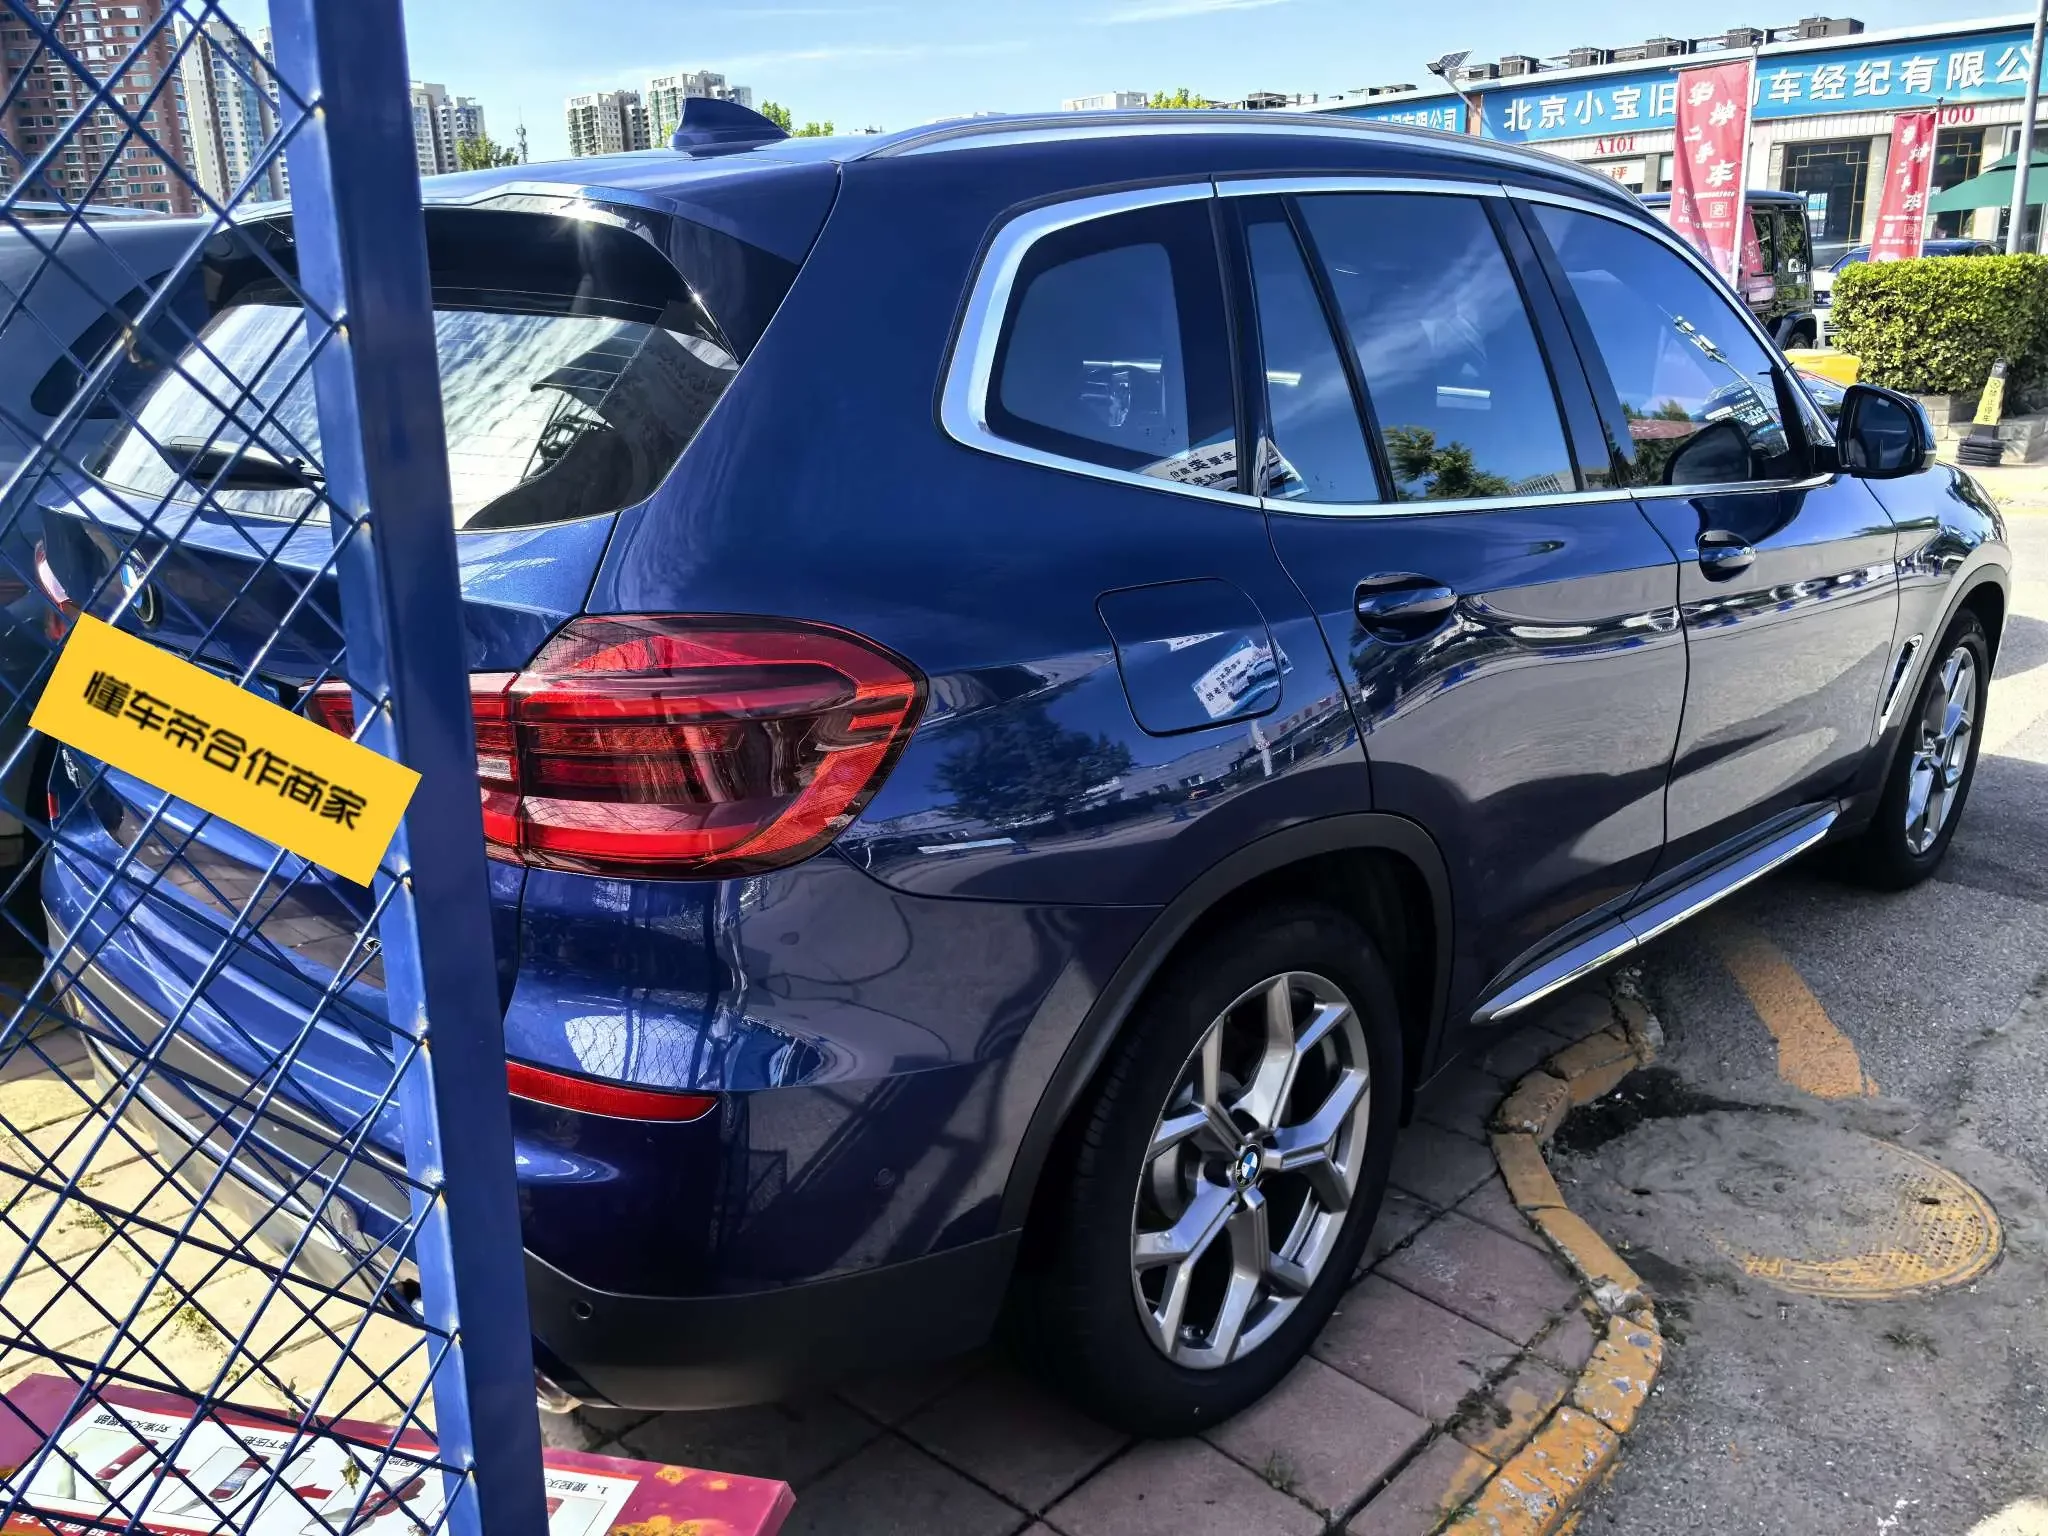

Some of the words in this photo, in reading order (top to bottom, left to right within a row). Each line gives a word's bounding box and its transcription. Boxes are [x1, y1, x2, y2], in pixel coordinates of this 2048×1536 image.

[1594, 135, 1636, 155] A101
[545, 1477, 609, 1495] 1、提起灭
